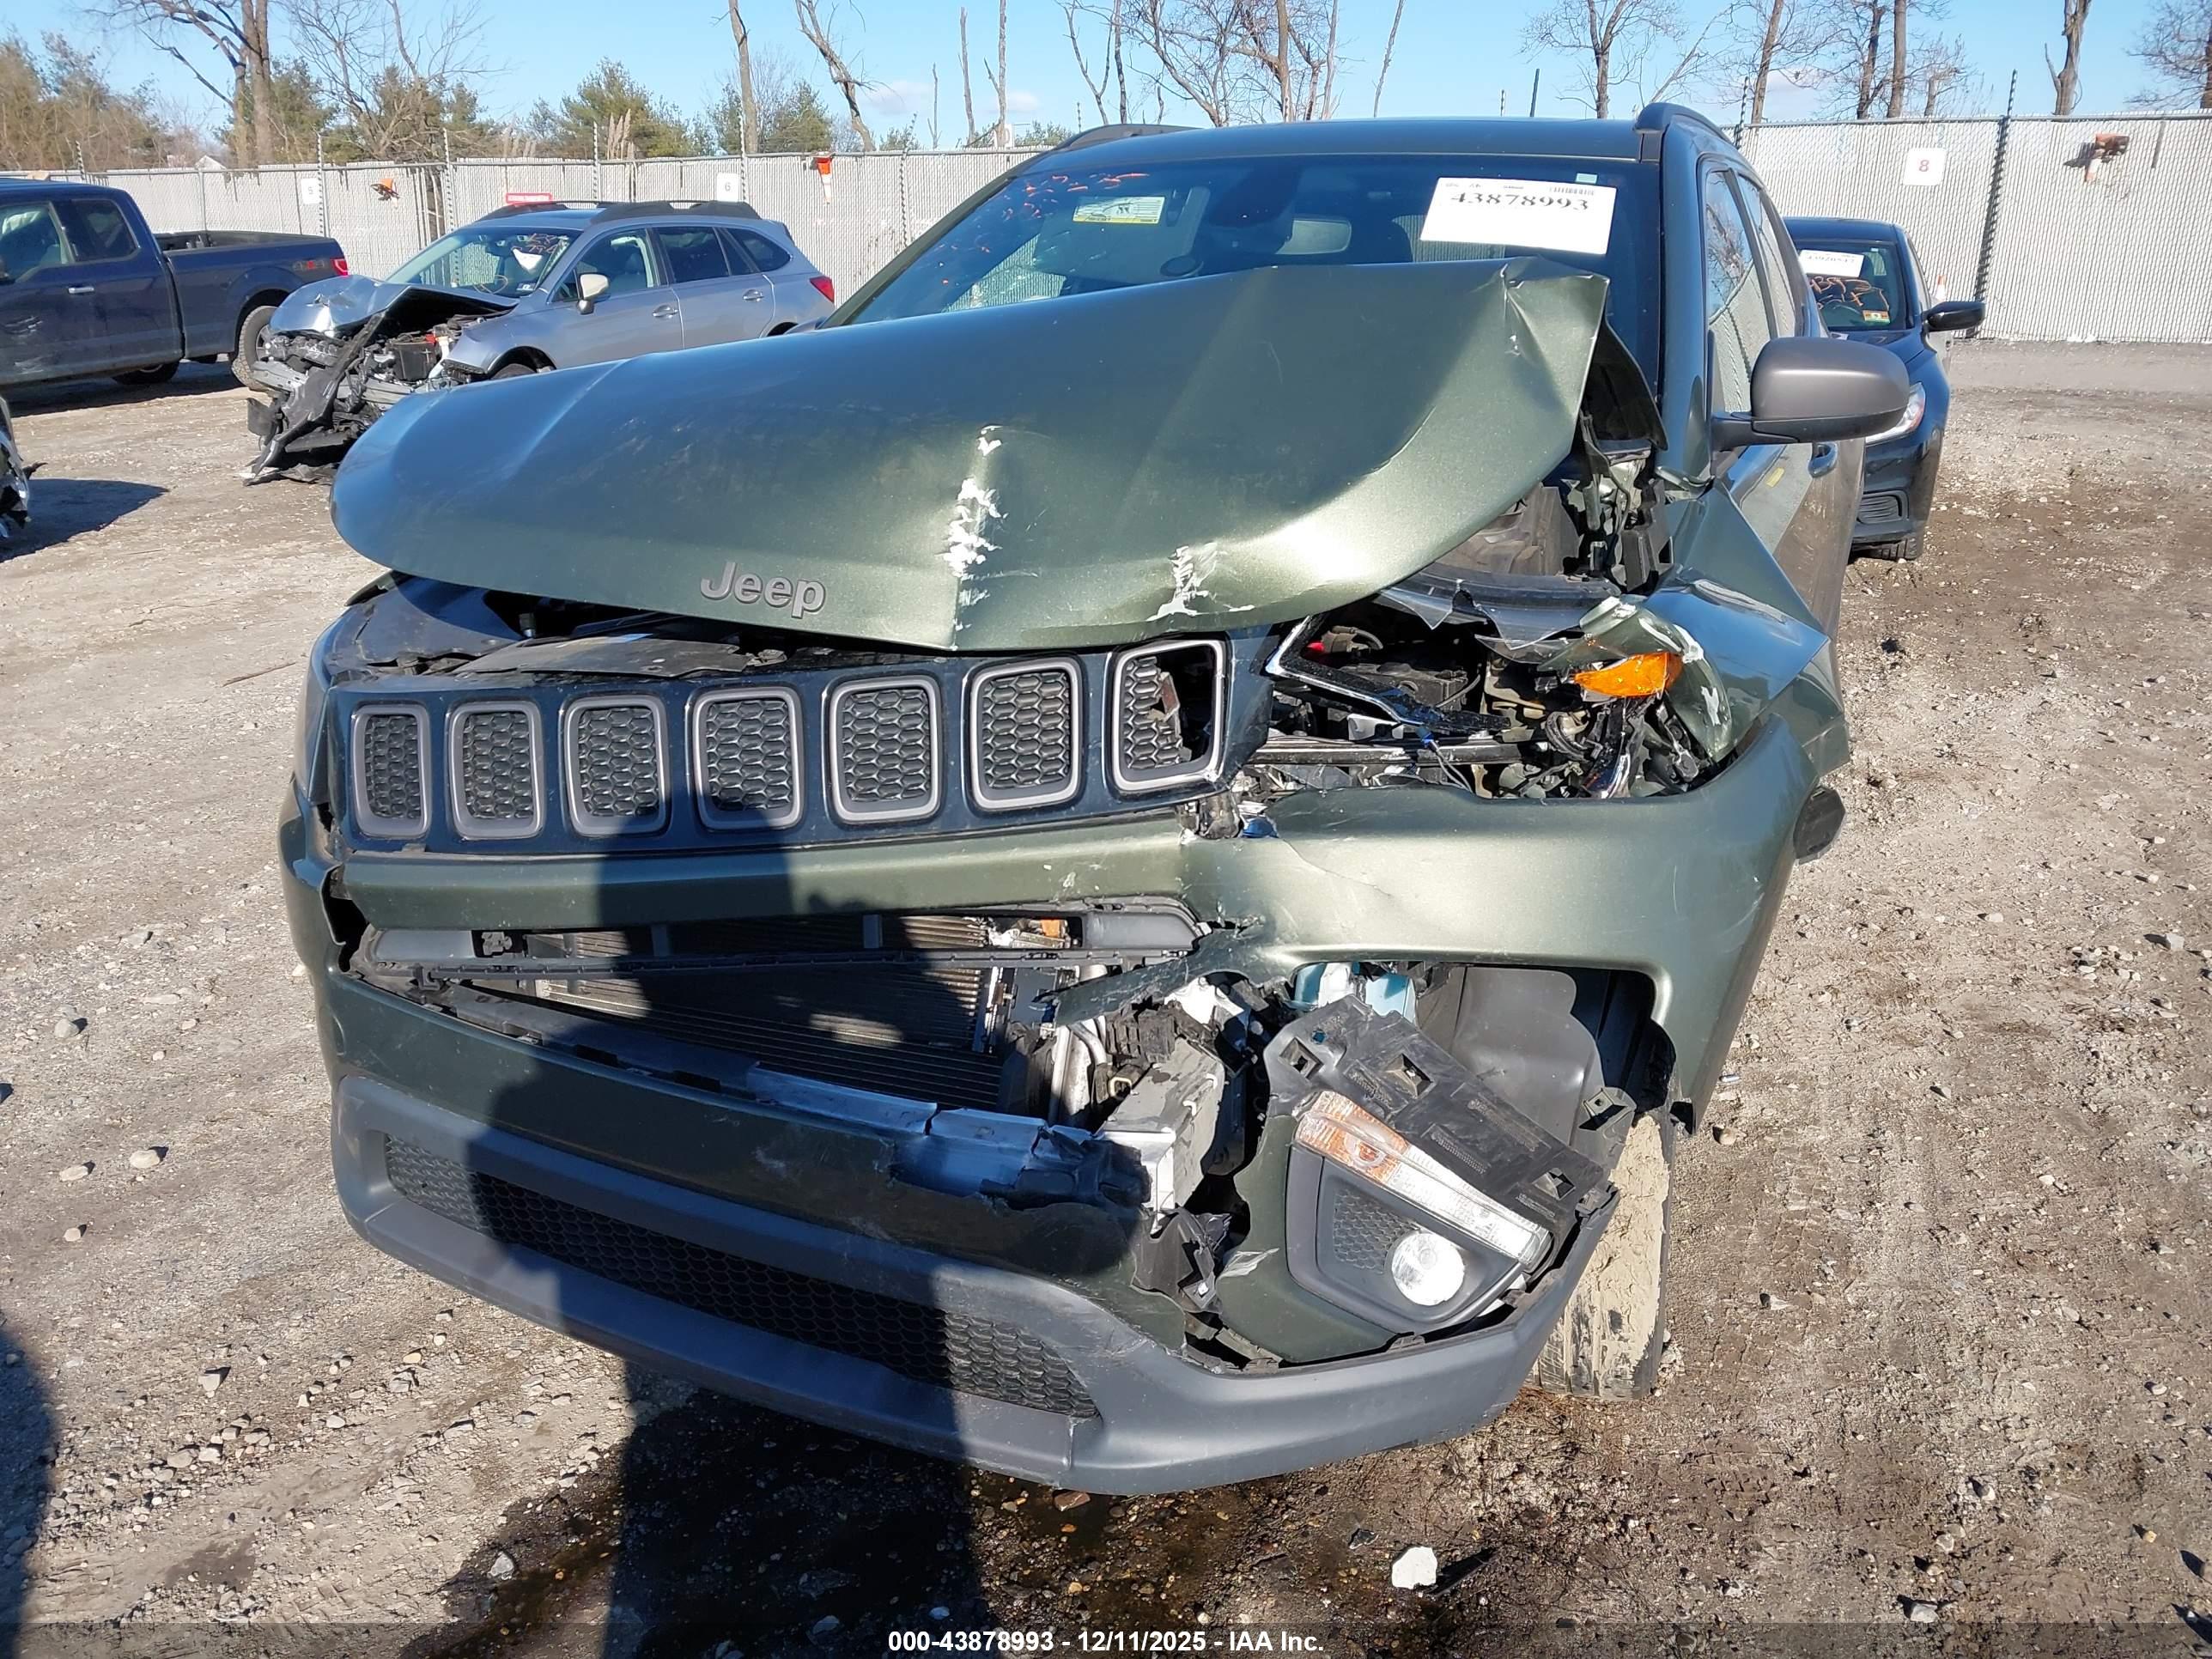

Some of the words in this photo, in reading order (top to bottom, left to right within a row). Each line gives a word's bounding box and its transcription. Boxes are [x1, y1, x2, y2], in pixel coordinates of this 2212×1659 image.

[1919, 159, 1929, 173] 8
[725, 181, 731, 192] 6
[1451, 191, 1588, 210] 43878993
[701, 562, 826, 619] Jeep
